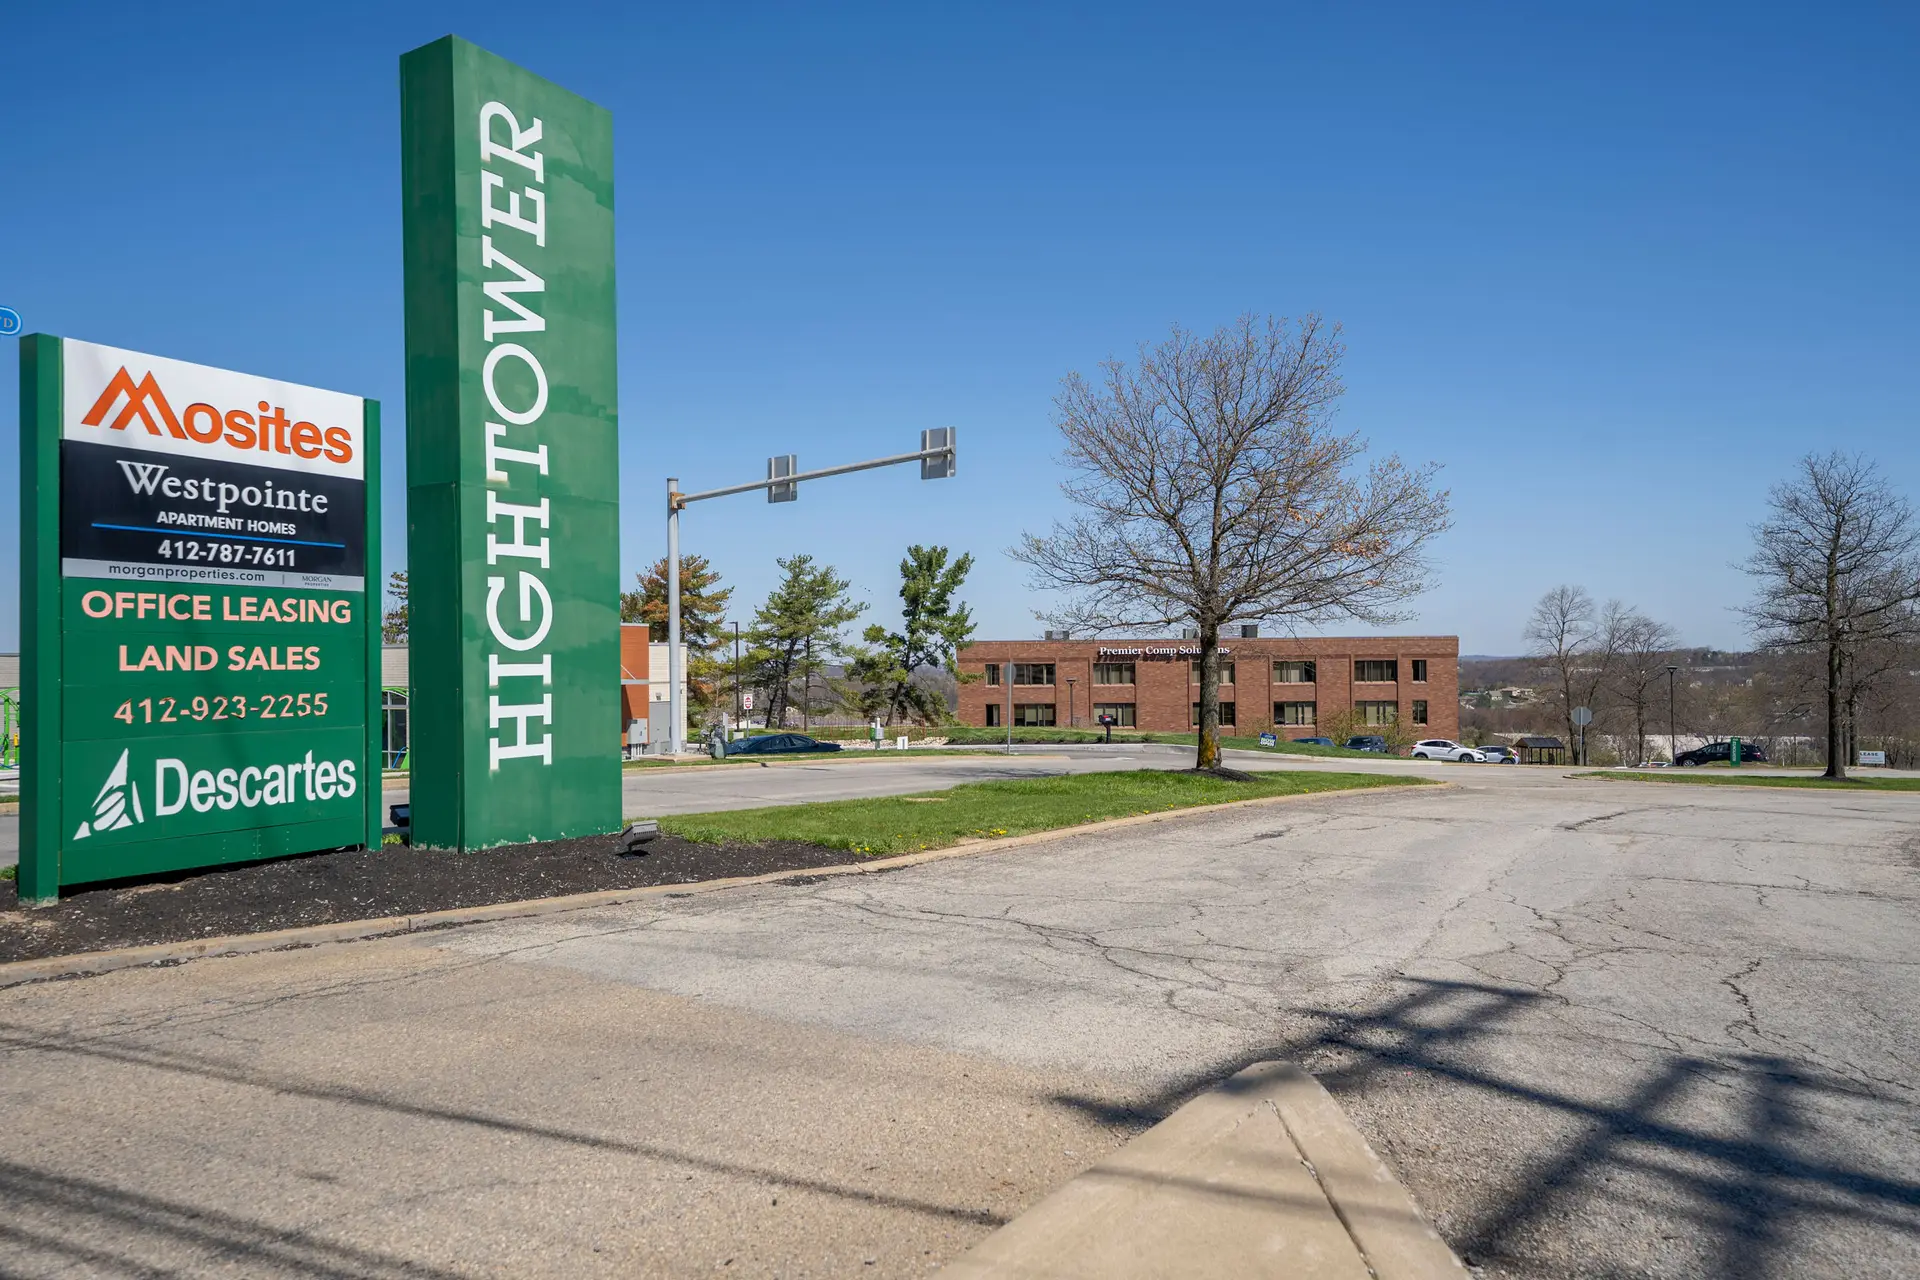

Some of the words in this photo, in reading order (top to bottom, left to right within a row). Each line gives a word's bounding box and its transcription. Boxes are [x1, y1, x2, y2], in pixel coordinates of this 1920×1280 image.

[81, 365, 353, 464] Mosites
[480, 101, 553, 773] HIGHTOWER
[116, 460, 328, 514] Westpointe
[157, 511, 243, 531] APARTMENT
[247, 519, 296, 536] HOMES
[158, 540, 296, 567] 412-787-7611
[109, 564, 265, 582] morganproperties.com
[81, 590, 212, 620] OFFICE
[223, 596, 351, 624] LEASING
[119, 645, 218, 671] LAND
[227, 646, 320, 671] SALES
[1100, 646, 1143, 655] Premier
[1145, 645, 1176, 656] Comp
[1179, 645, 1230, 655] Soluns
[114, 693, 328, 724] 412-923-2255
[155, 749, 357, 817] Descartes
